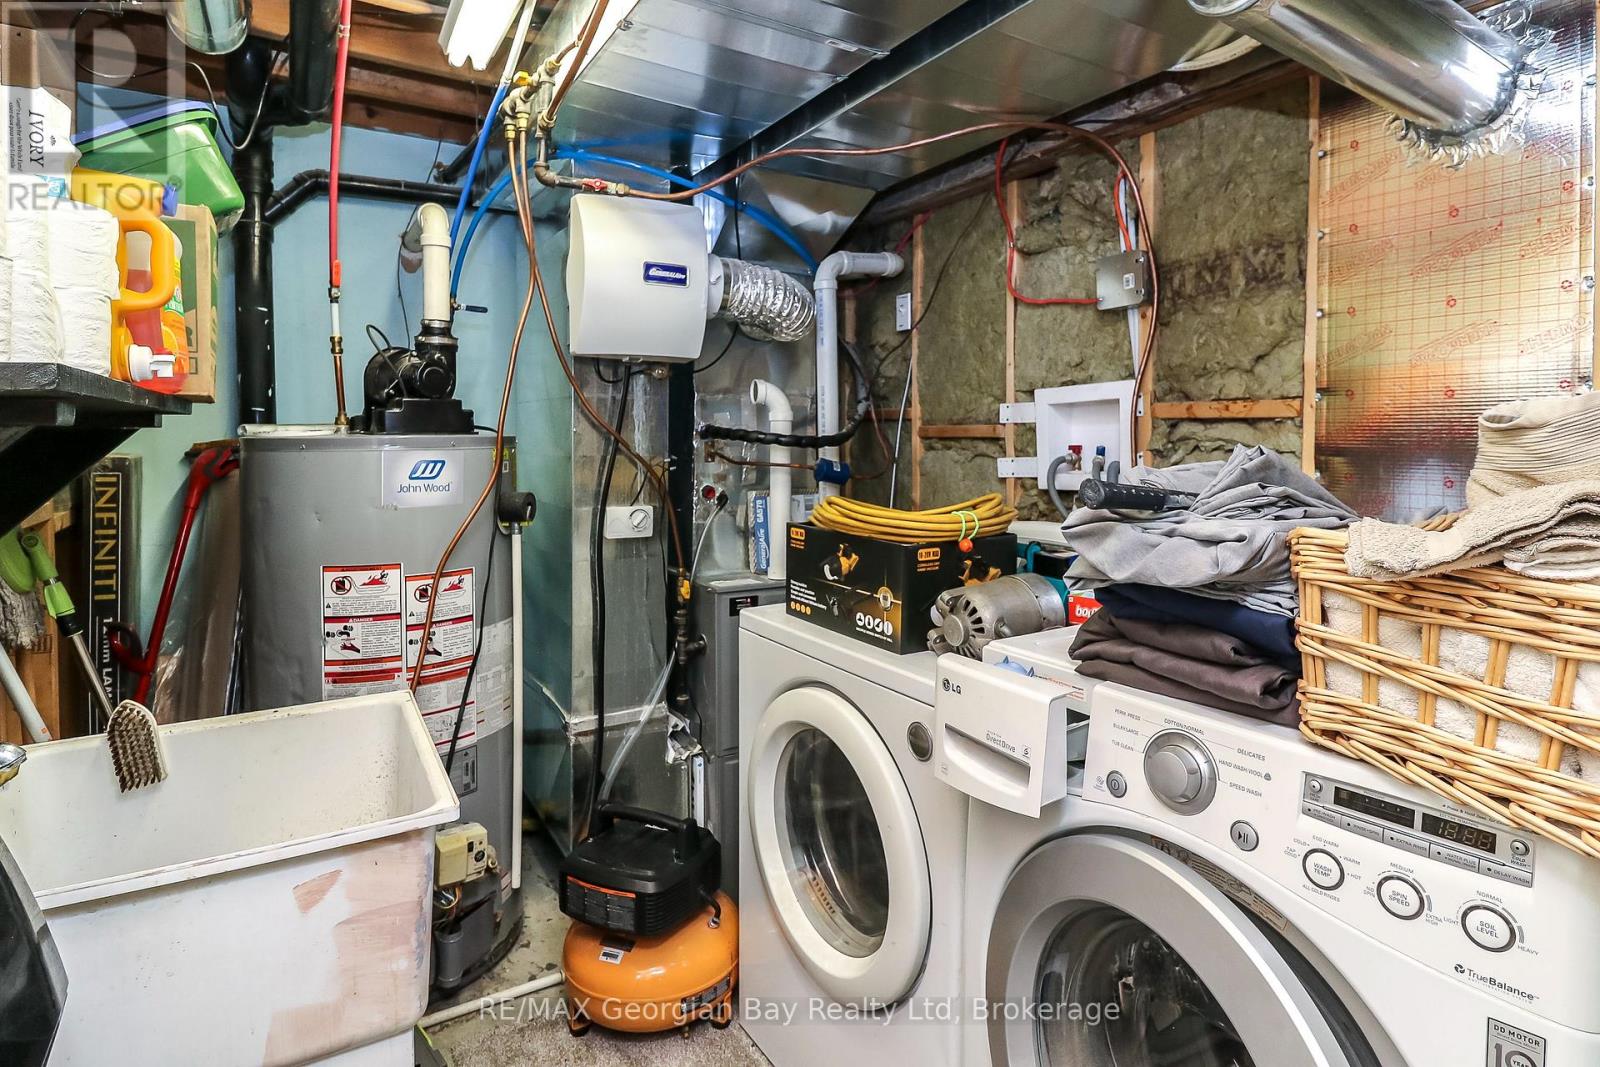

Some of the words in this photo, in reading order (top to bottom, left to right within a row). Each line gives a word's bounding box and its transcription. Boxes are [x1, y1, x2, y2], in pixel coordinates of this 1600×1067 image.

[28, 109, 45, 168] IVORY
[397, 483, 422, 493] John
[423, 482, 450, 492] Wood
[94, 476, 118, 601] INFINITI
[102, 667, 113, 700] LAM
[951, 683, 962, 694] LG
[1237, 748, 1266, 761] DELICATES
[1218, 759, 1233, 768] HAND
[1229, 782, 1246, 792] SPEED
[1246, 788, 1262, 797] WASH
[1396, 838, 1412, 848] EXTRA
[1446, 852, 1463, 862] WATER
[1463, 858, 1477, 866] PLUS
[1313, 862, 1332, 874] WASH
[1390, 862, 1414, 874] MEDIUM
[1350, 873, 1362, 881] HOT
[1494, 869, 1512, 879] DELAY
[1512, 875, 1530, 885] WASH
[1302, 884, 1311, 892] ALL
[1388, 895, 1410, 907] SPEED
[1391, 890, 1408, 901] SPIN
[1476, 890, 1503, 904] NORMAL
[1425, 913, 1443, 924] EXTRA
[1443, 916, 1459, 925] LIGHT
[1479, 920, 1497, 932] SOIL
[1476, 926, 1499, 939] LEVEL
[1517, 944, 1540, 956] HEAVY
[1493, 1024, 1506, 1034] DD
[1508, 1030, 1541, 1047] MOTOR
